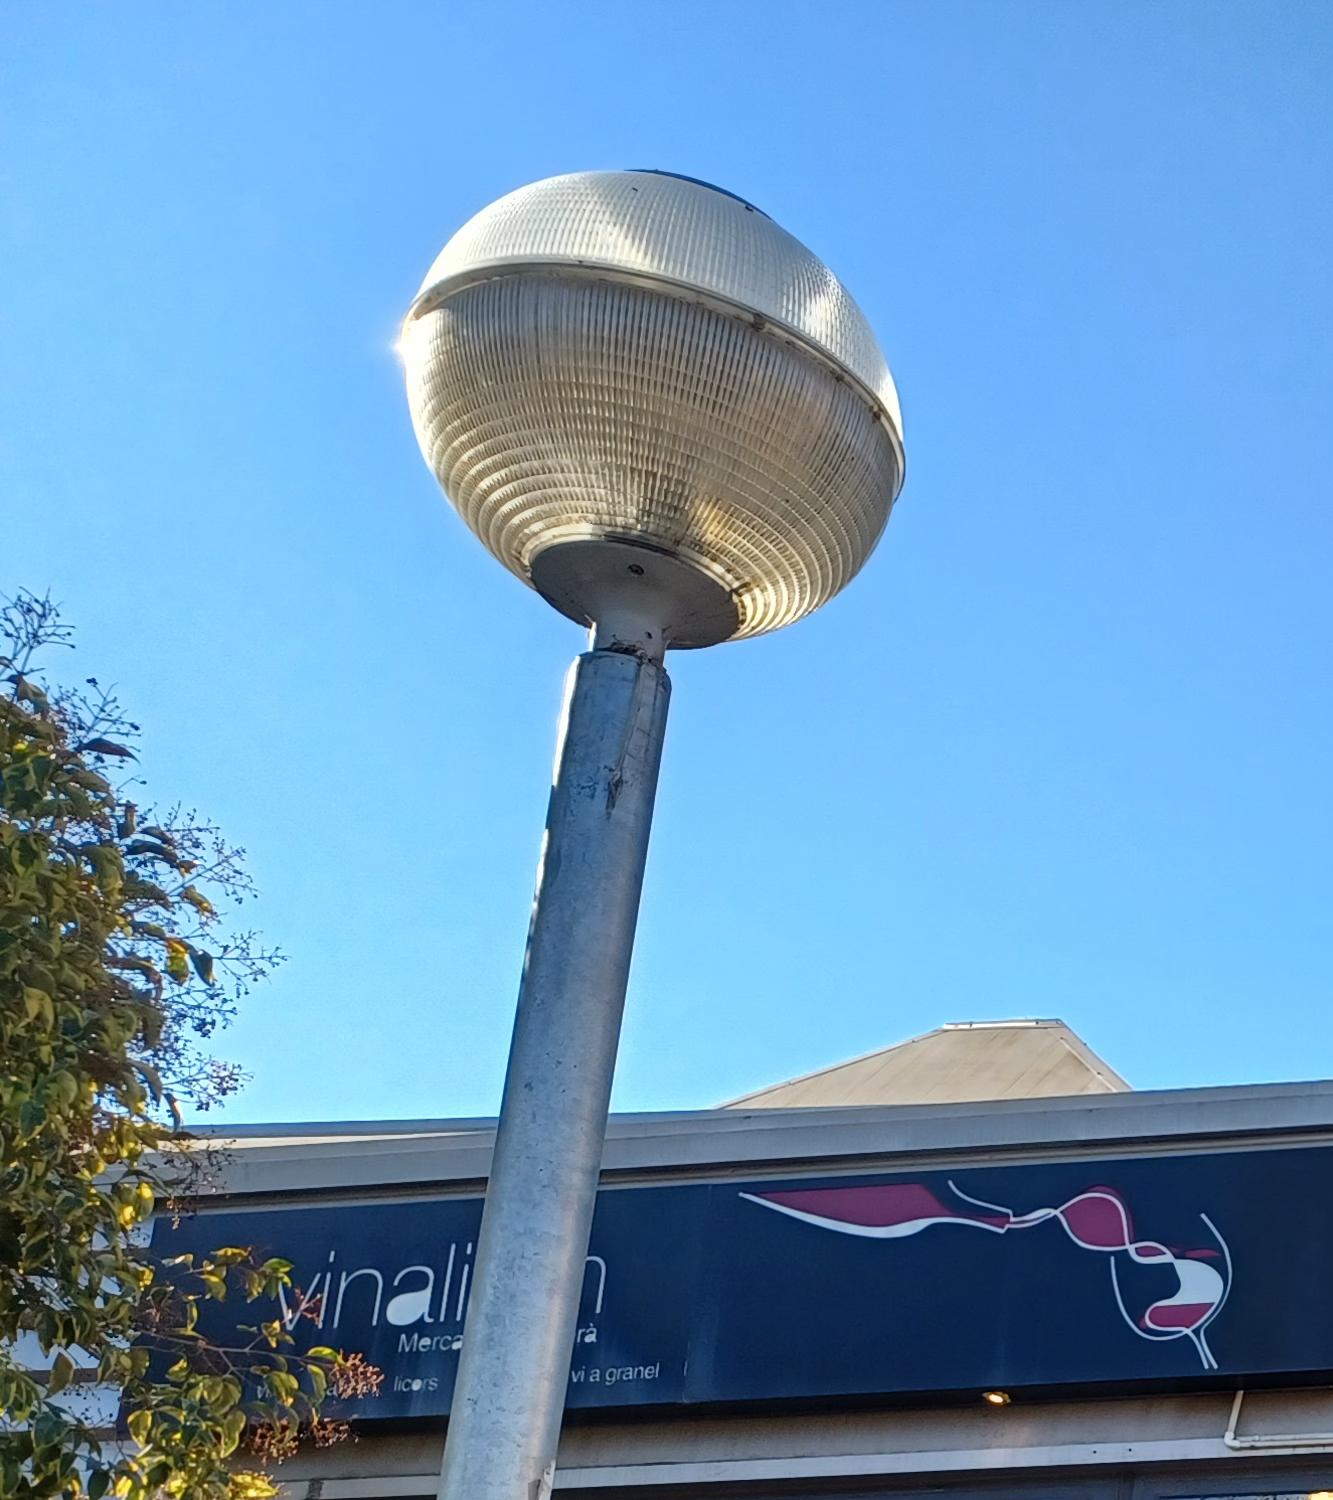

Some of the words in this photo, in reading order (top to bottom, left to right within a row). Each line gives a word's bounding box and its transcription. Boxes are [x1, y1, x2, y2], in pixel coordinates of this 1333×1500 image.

[278, 1242, 607, 1331] vinali
[394, 1376, 439, 1392] licors
[605, 1362, 660, 1385] granel
